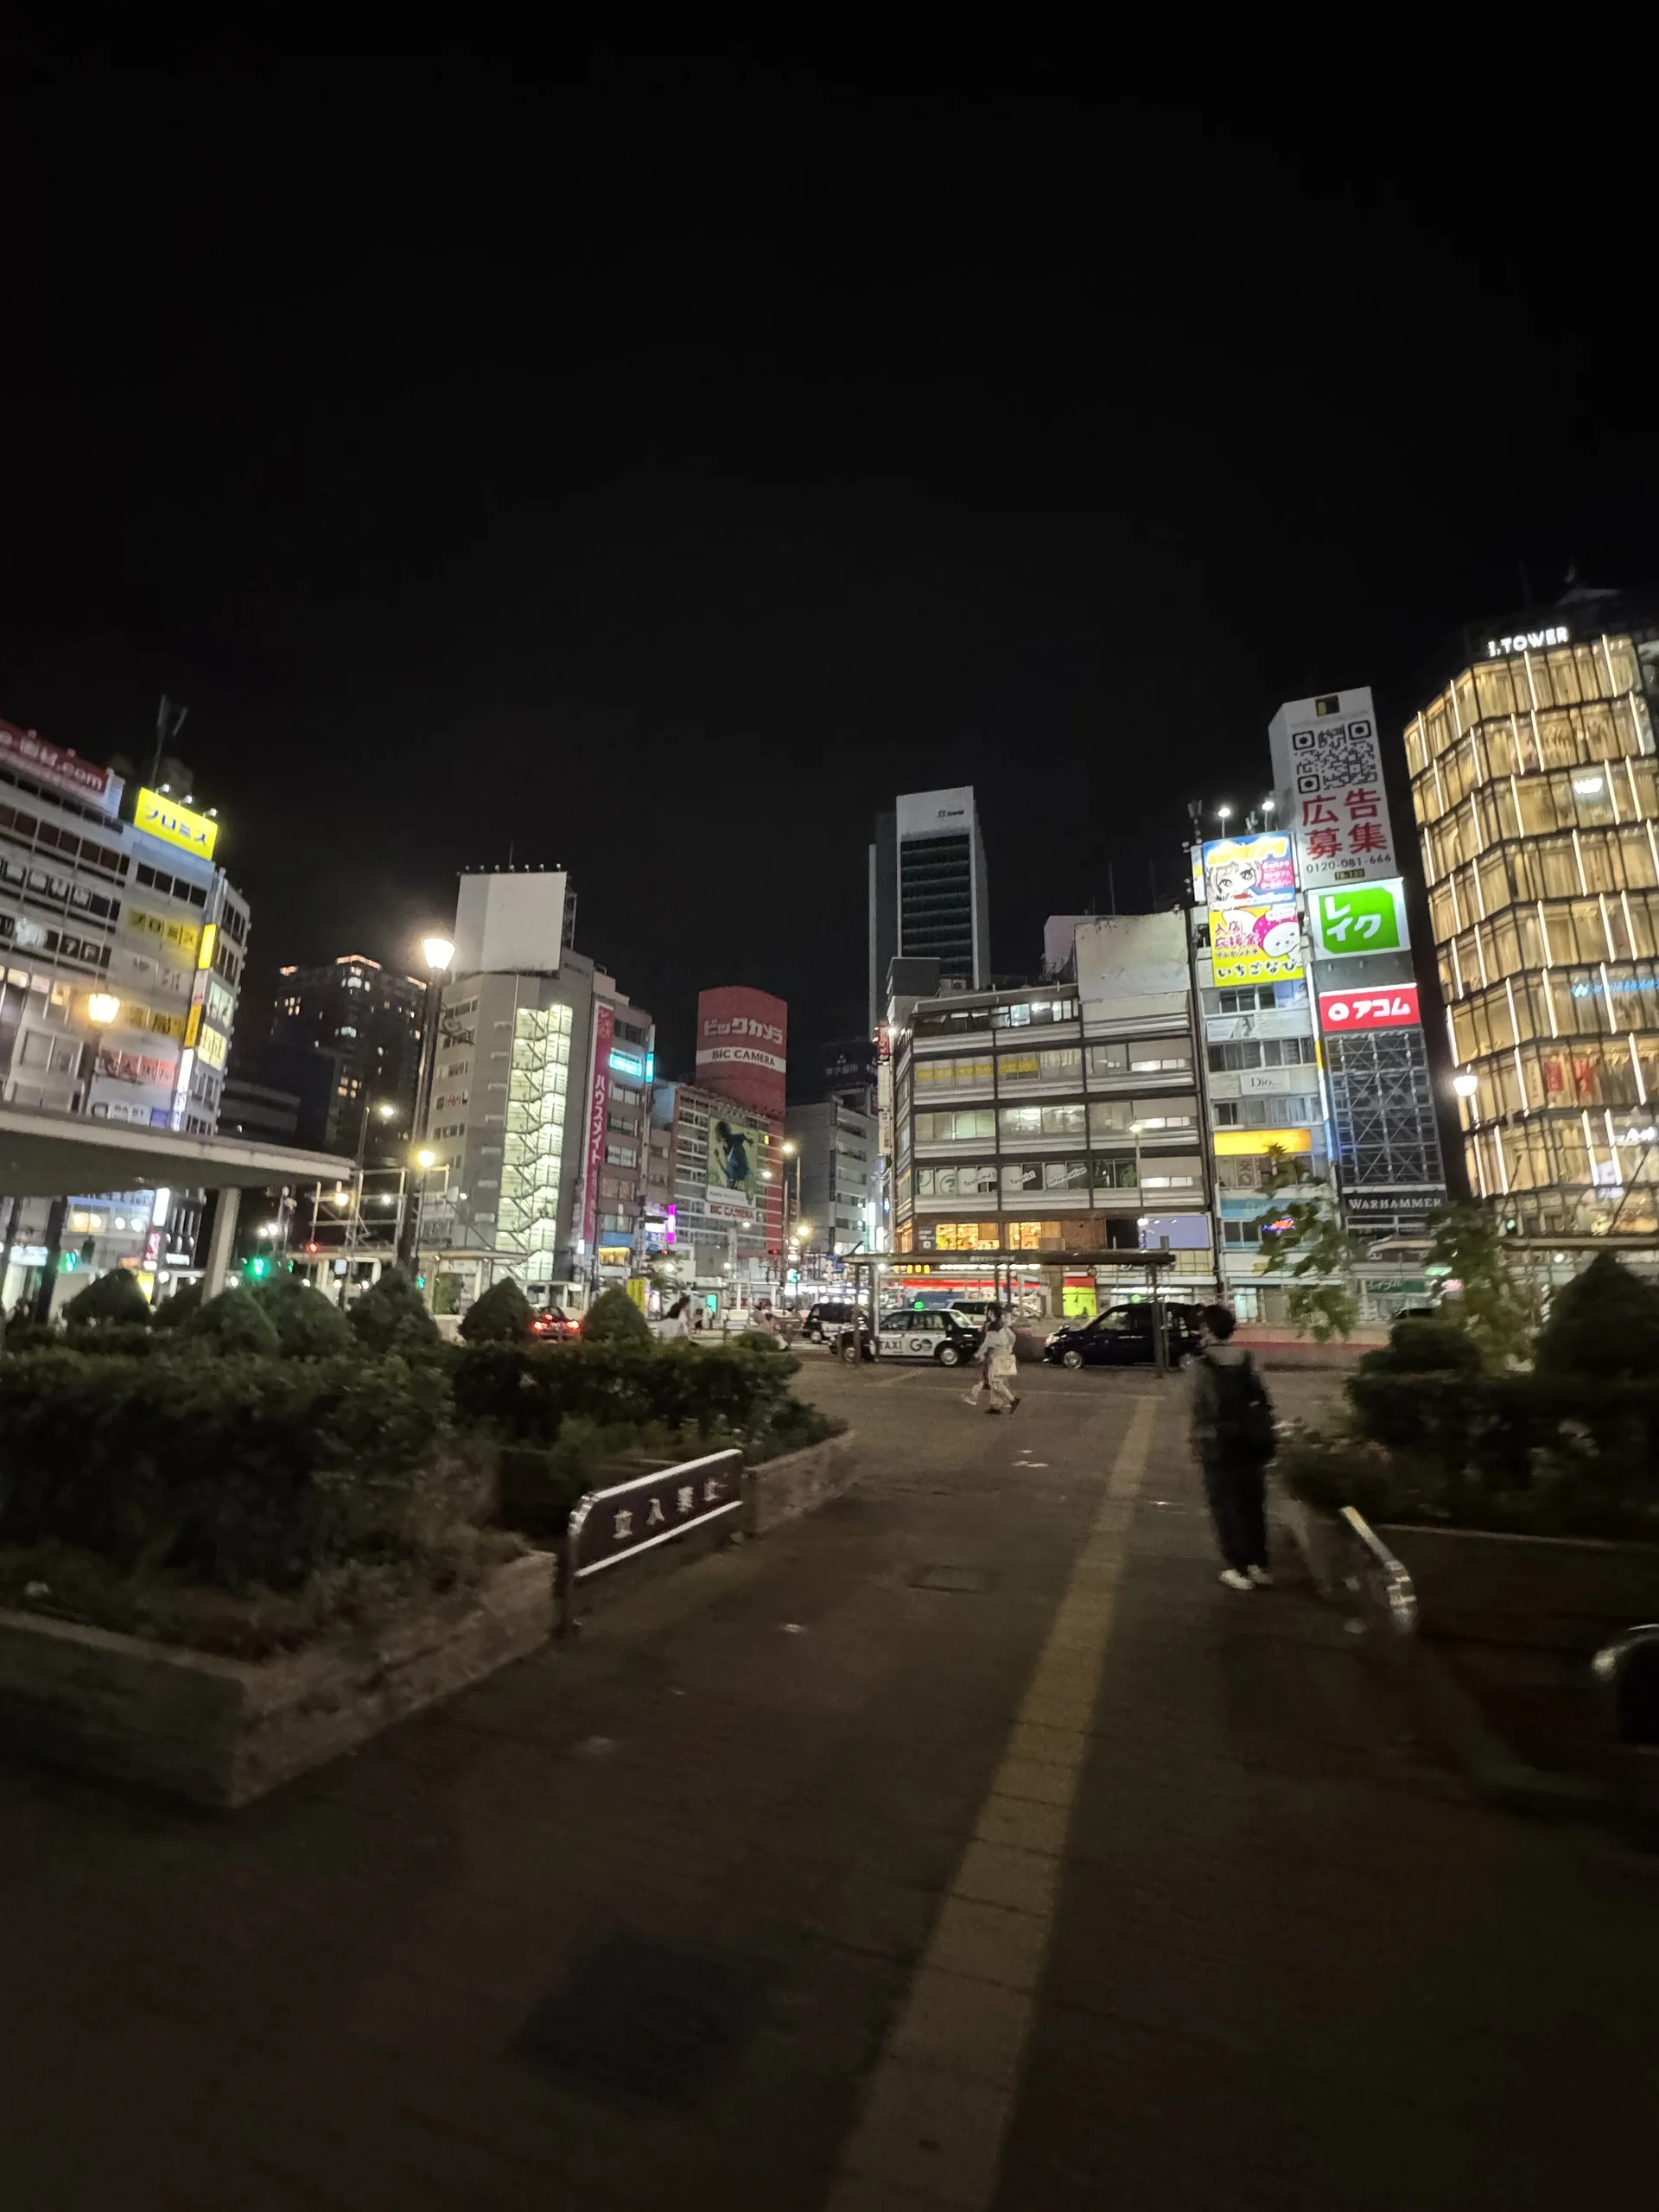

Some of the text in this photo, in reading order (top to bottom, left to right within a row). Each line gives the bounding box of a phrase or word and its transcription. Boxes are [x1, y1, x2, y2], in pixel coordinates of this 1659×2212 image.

[1302, 787, 1382, 827] 広告
[1305, 822, 1389, 861] 募集
[1306, 852, 1392, 874] 0120-081-666
[1325, 896, 1382, 943] レイク
[1218, 959, 1297, 978] いちごなび
[1352, 996, 1411, 1020] アコム
[704, 1017, 783, 1045] ビックカメラ
[711, 1049, 775, 1066] BIC CAMERA
[591, 1074, 606, 1166] ハウスメイト
[1009, 1172, 1037, 1185] Tourist
[1348, 1198, 1442, 1210] WARHAMMER
